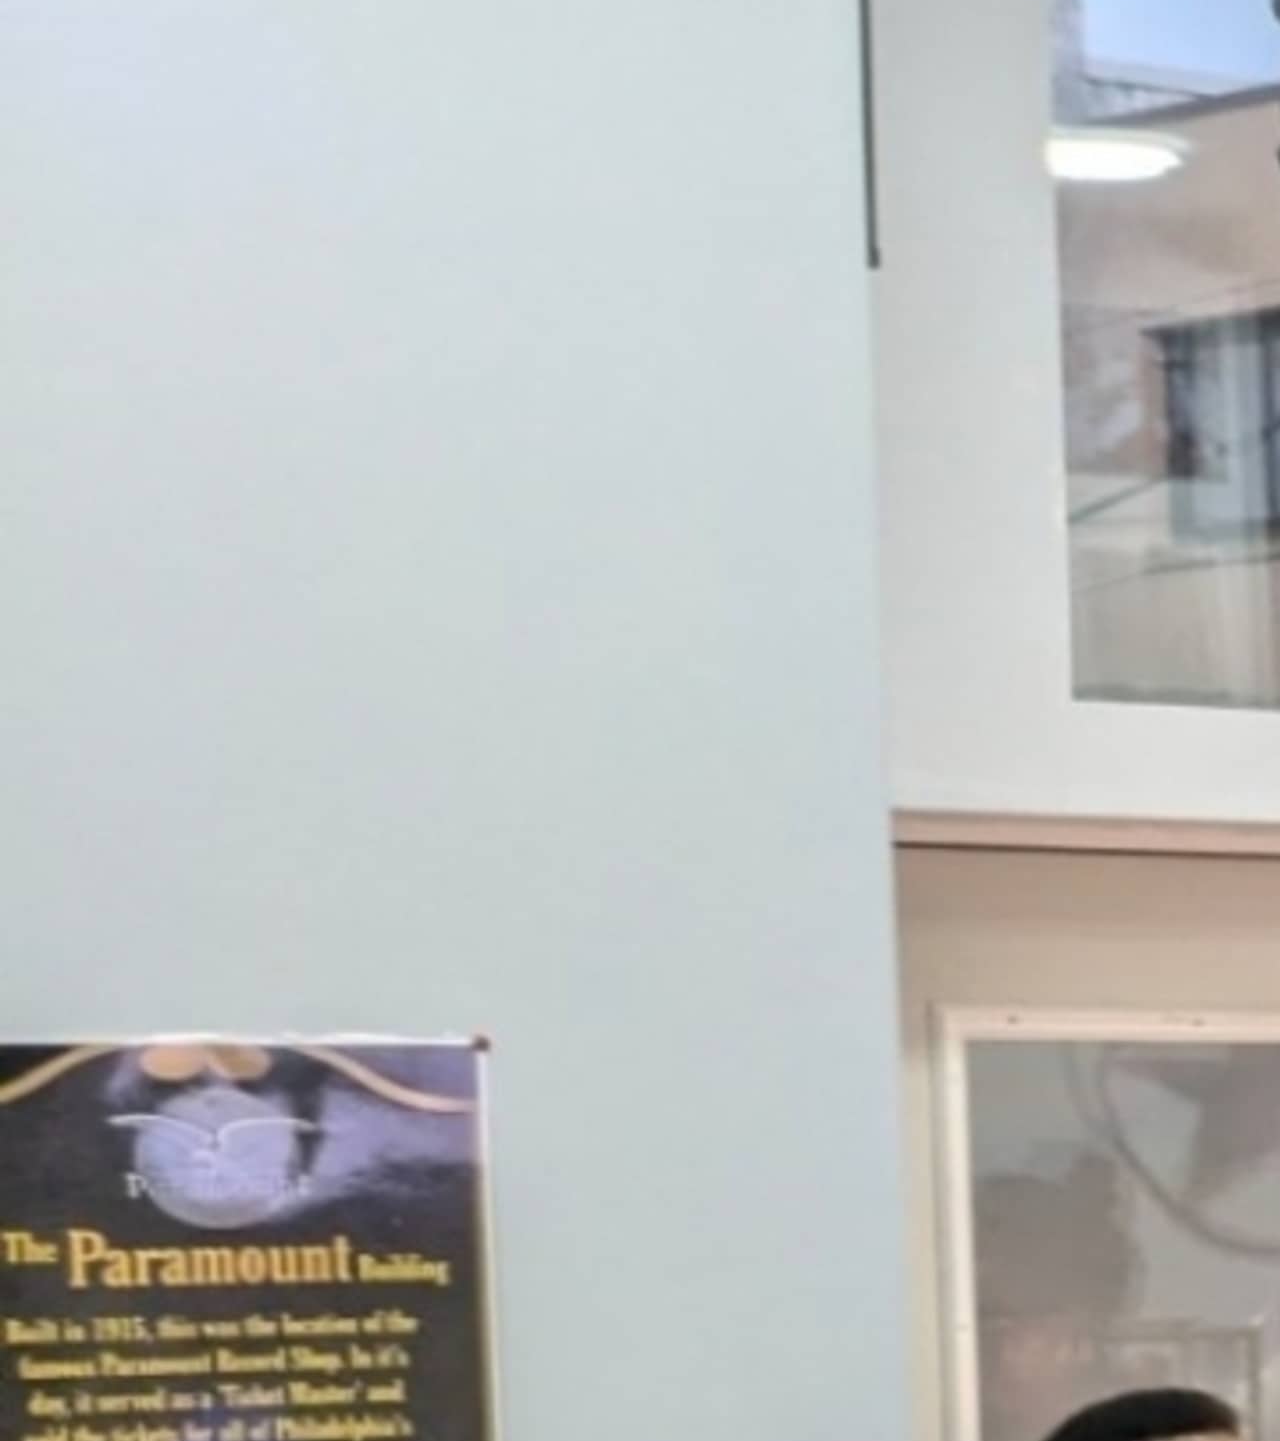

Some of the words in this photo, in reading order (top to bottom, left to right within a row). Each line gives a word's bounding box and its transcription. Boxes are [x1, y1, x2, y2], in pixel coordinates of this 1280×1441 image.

[2, 1230, 59, 1264] The
[66, 1227, 355, 1289] Paramount
[243, 1312, 277, 1337] the
